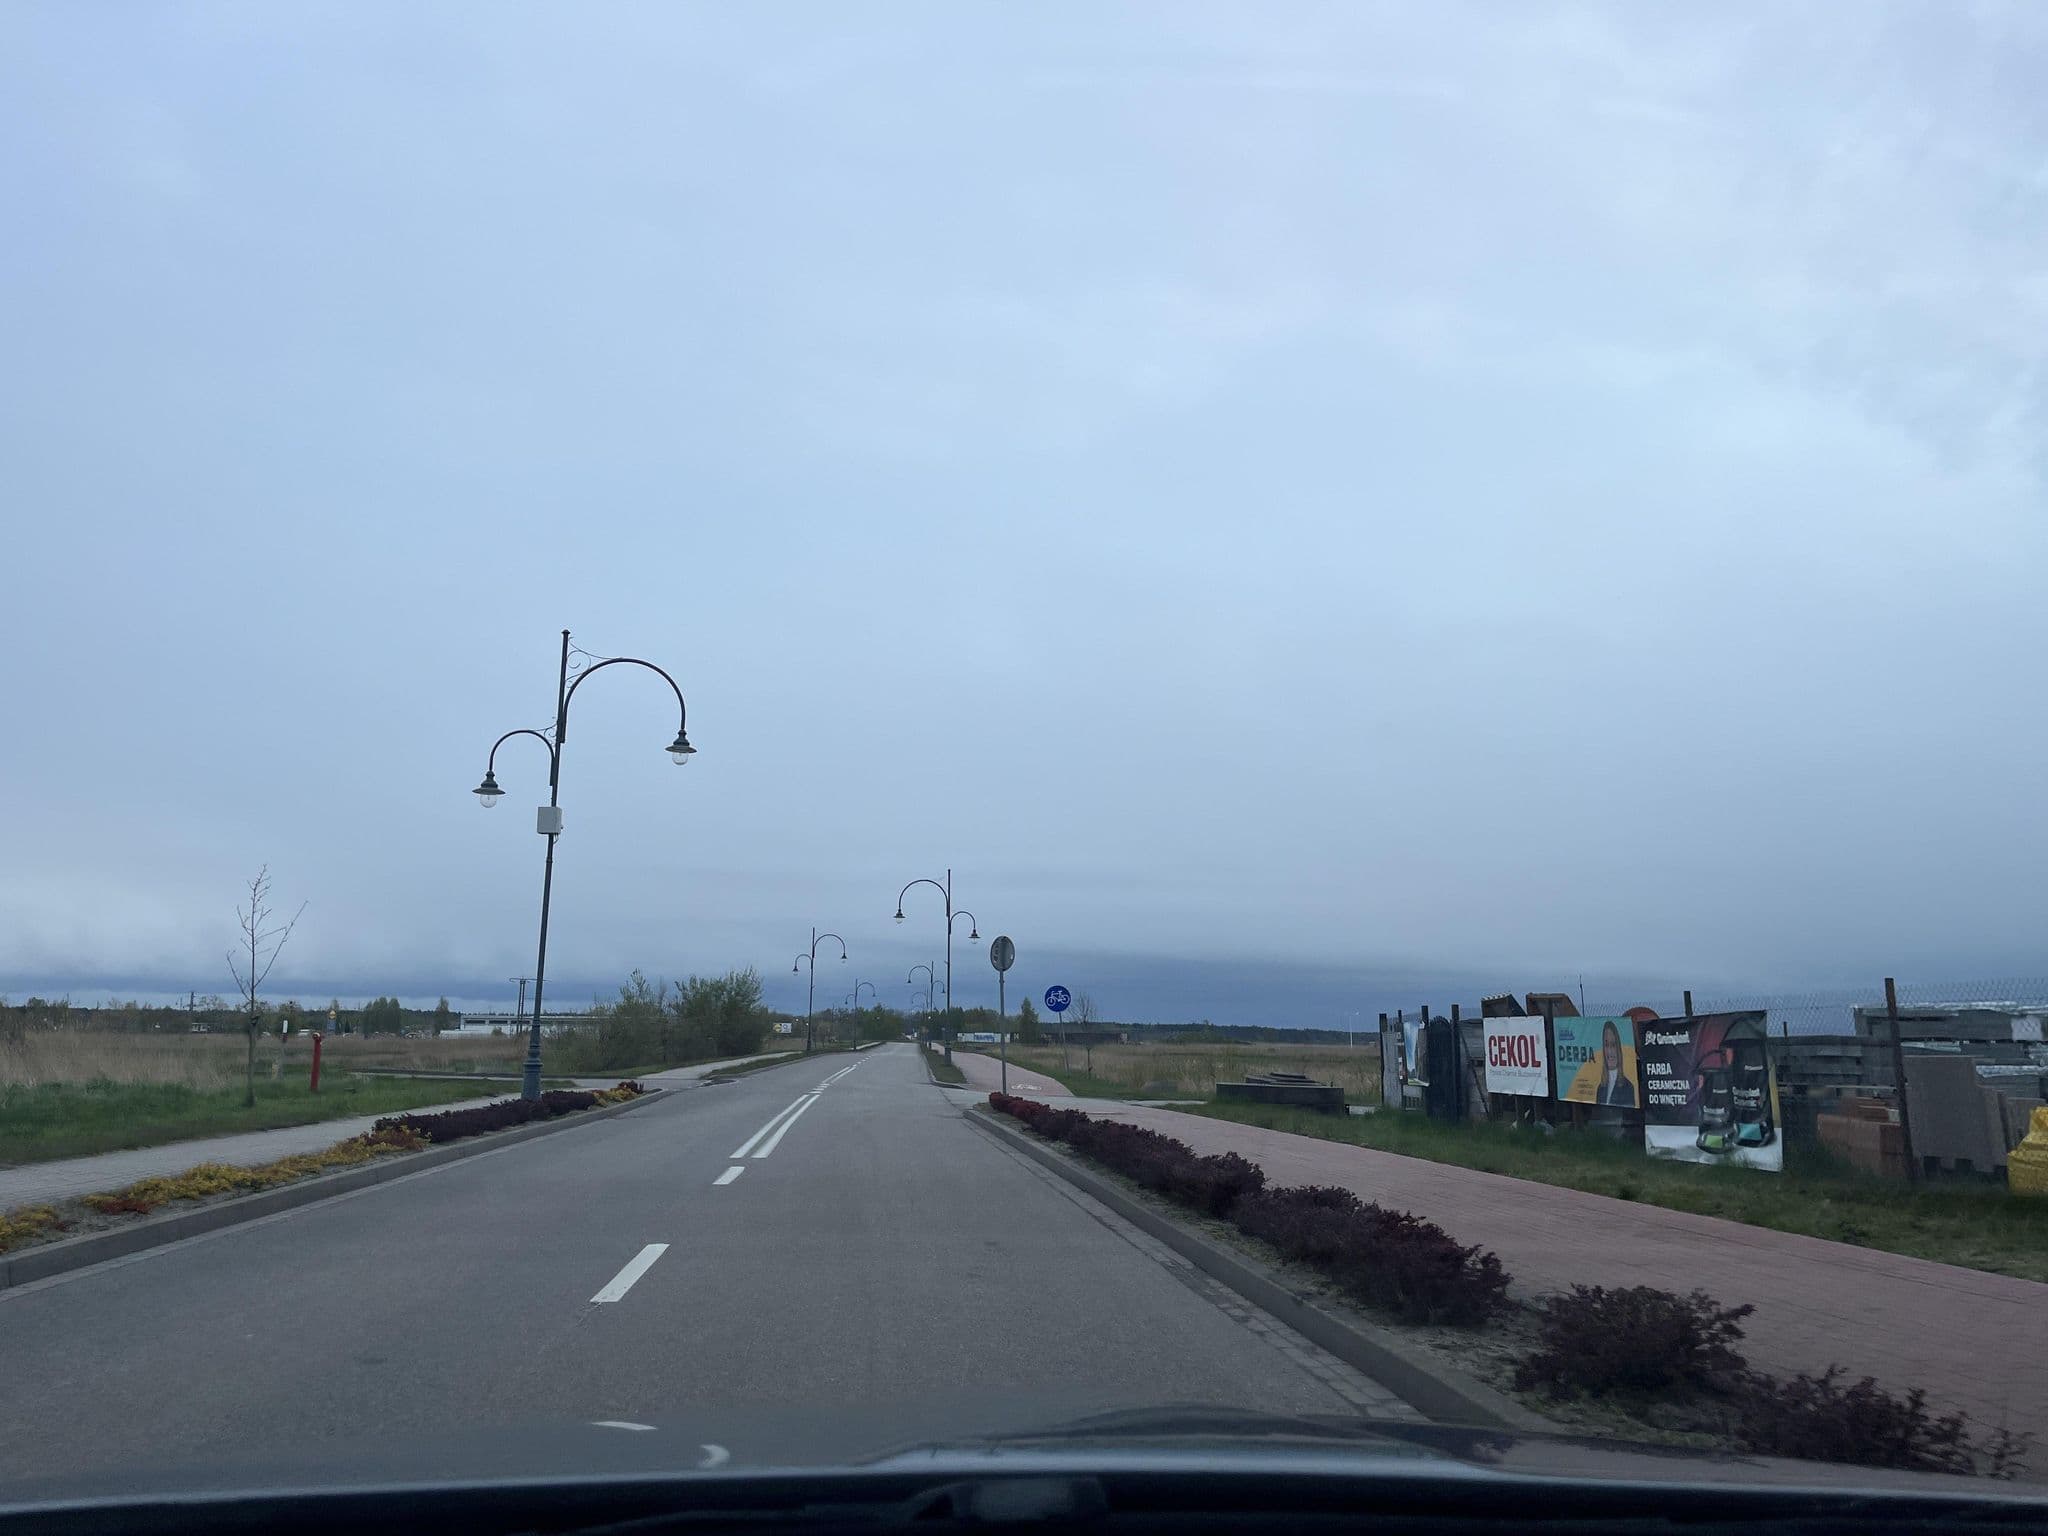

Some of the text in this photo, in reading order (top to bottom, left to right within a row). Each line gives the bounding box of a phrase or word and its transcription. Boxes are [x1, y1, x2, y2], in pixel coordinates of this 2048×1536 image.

[1488, 1034, 1541, 1068] CEKOL
[1558, 1046, 1596, 1063] DERBA
[1646, 1063, 1673, 1075] FARBA
[1648, 1080, 1690, 1090] CERAMICZNA
[1649, 1094, 1659, 1104] DO
